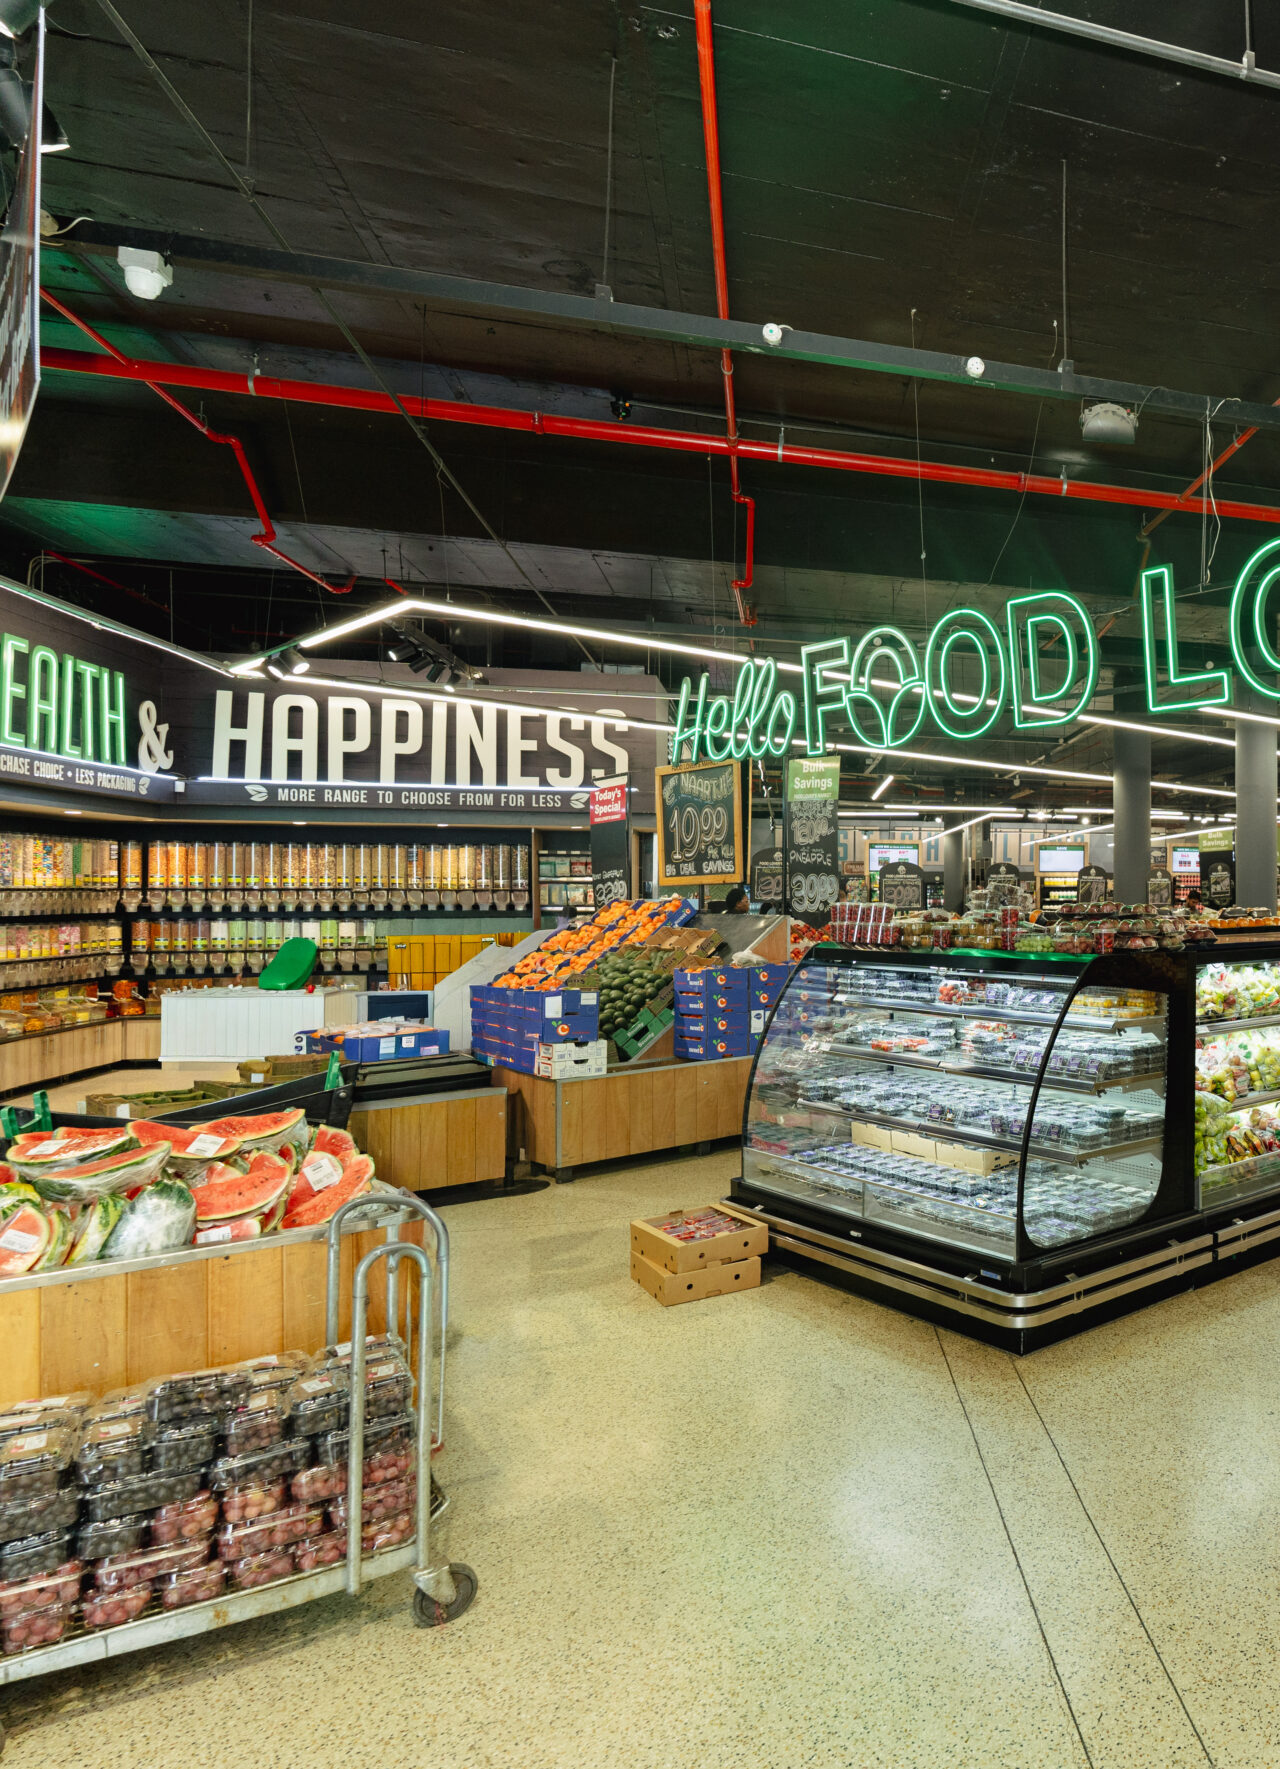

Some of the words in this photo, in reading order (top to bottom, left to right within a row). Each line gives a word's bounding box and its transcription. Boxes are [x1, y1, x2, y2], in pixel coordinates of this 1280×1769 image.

[671, 656, 797, 767] Hello
[800, 590, 1098, 756] FOOD
[211, 689, 630, 789] HAPPINESS
[802, 762, 825, 773] Bulk
[33, 760, 65, 781] CHOICE
[75, 768, 95, 786] LESS
[97, 772, 136, 793] PACKAGING
[794, 777, 833, 790] Savings
[277, 788, 316, 802] MORE
[324, 789, 368, 804] RANGE
[377, 790, 393, 804] TO
[401, 791, 451, 805] CHOOSE
[459, 793, 494, 806] FROM
[501, 794, 525, 807] FOR
[532, 794, 562, 808] LESS
[594, 788, 621, 801] Today's
[594, 801, 621, 816] Special
[789, 850, 832, 867] PINEAPPLE
[680, 862, 696, 875] DEAL
[702, 860, 735, 874] SAVINGS
